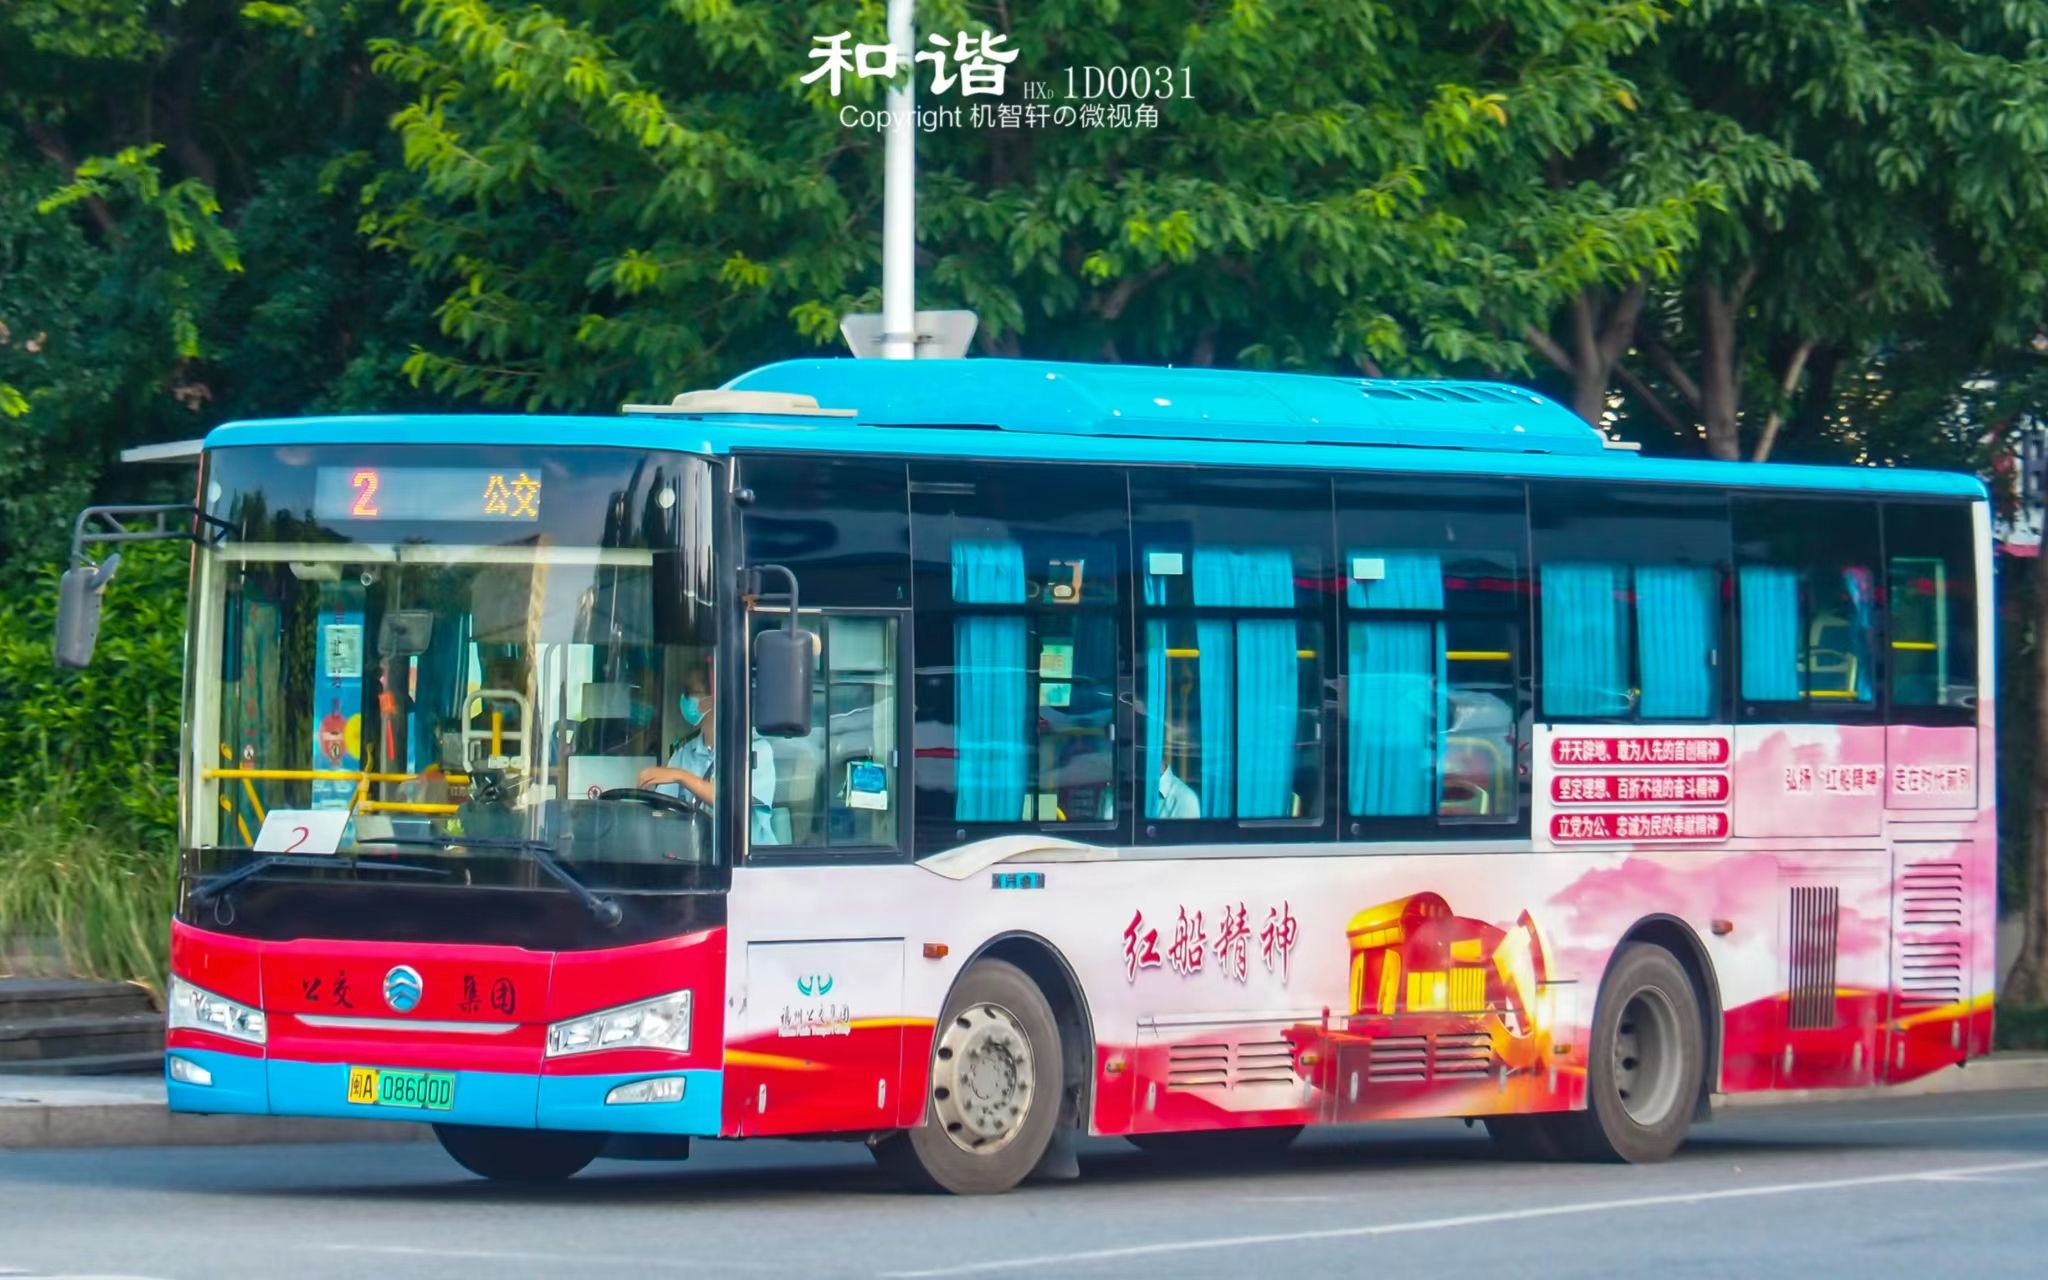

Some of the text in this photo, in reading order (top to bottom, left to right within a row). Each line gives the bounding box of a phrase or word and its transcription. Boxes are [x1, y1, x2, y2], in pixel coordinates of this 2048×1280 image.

[352, 471, 378, 516] 2
[483, 473, 541, 517] 公交
[1122, 899, 1298, 984] 红船精神
[302, 969, 516, 1015] 公交 集团
